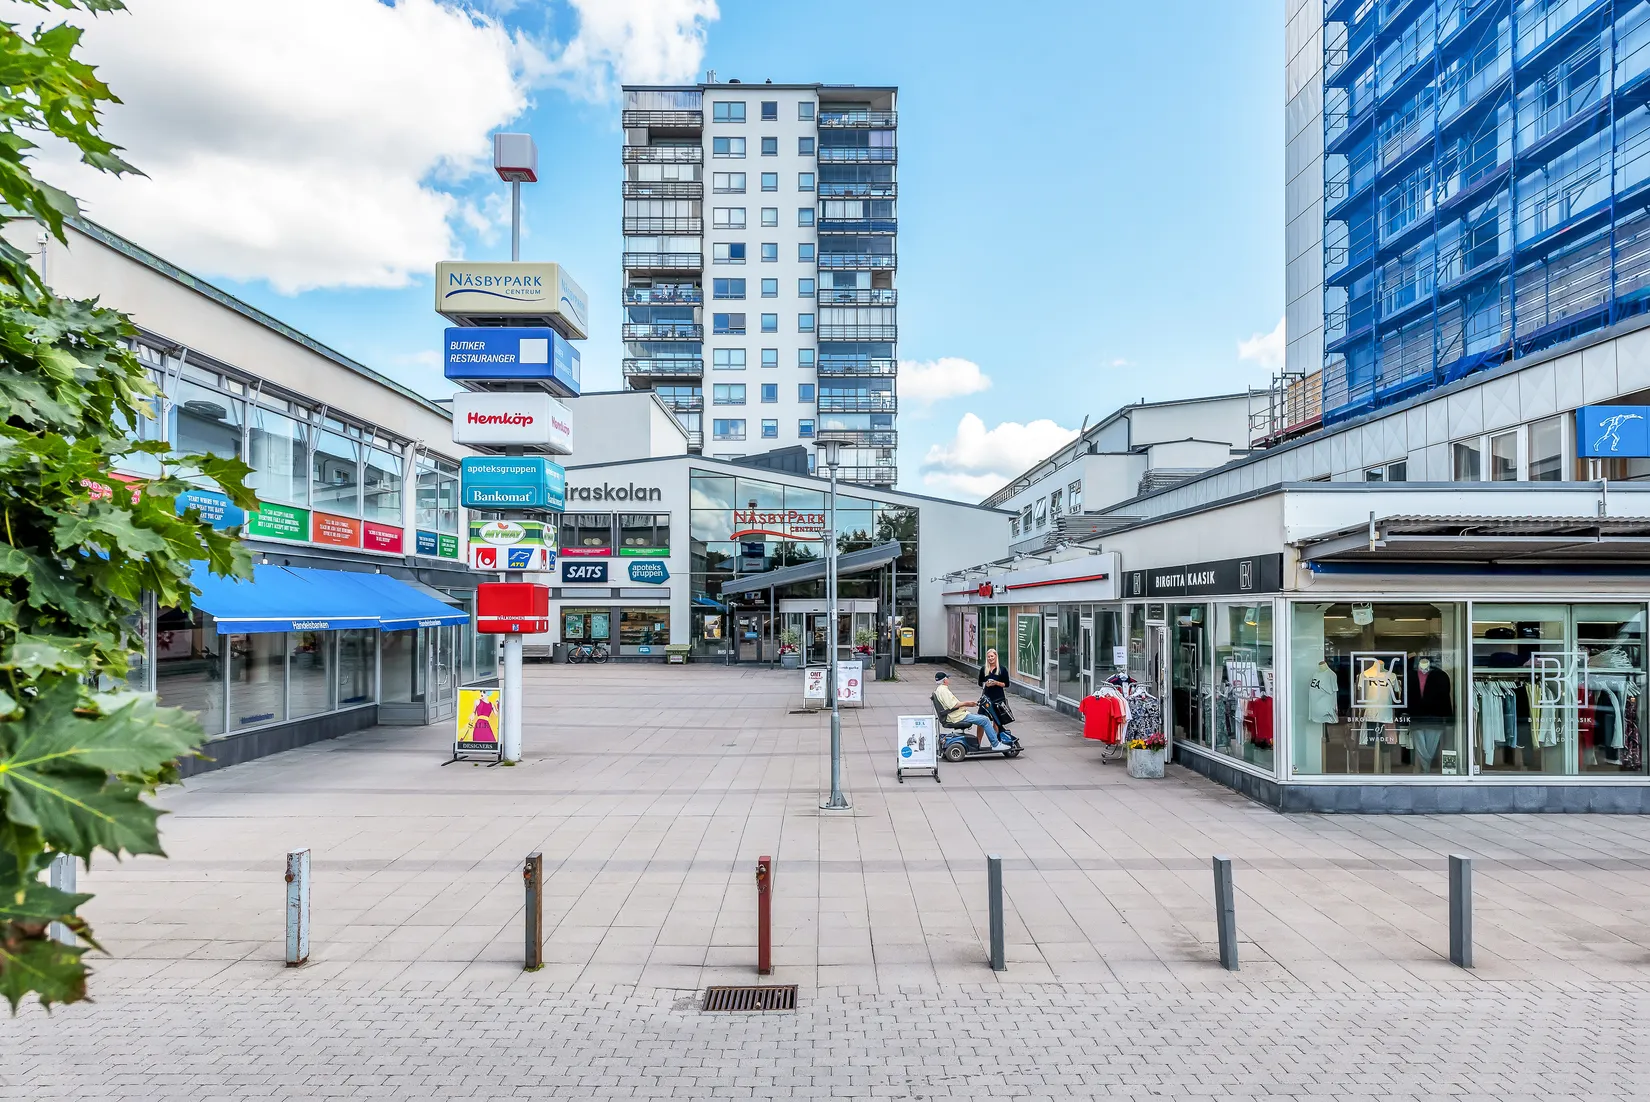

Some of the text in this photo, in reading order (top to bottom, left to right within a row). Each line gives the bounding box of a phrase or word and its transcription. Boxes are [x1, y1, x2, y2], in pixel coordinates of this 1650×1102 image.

[450, 272, 542, 287] NÄSBYPARK
[450, 342, 485, 350] BUTIKER
[450, 354, 515, 363] RESTAURANGER
[467, 412, 533, 427] Hemköp
[468, 465, 536, 474] apoteksgruppen
[564, 482, 662, 501] iraskolan
[567, 566, 603, 578] SATS
[632, 570, 663, 578] gruppen
[1156, 571, 1215, 588] BIRGITTA KAASIK
[292, 621, 329, 630] Handelsbanken
